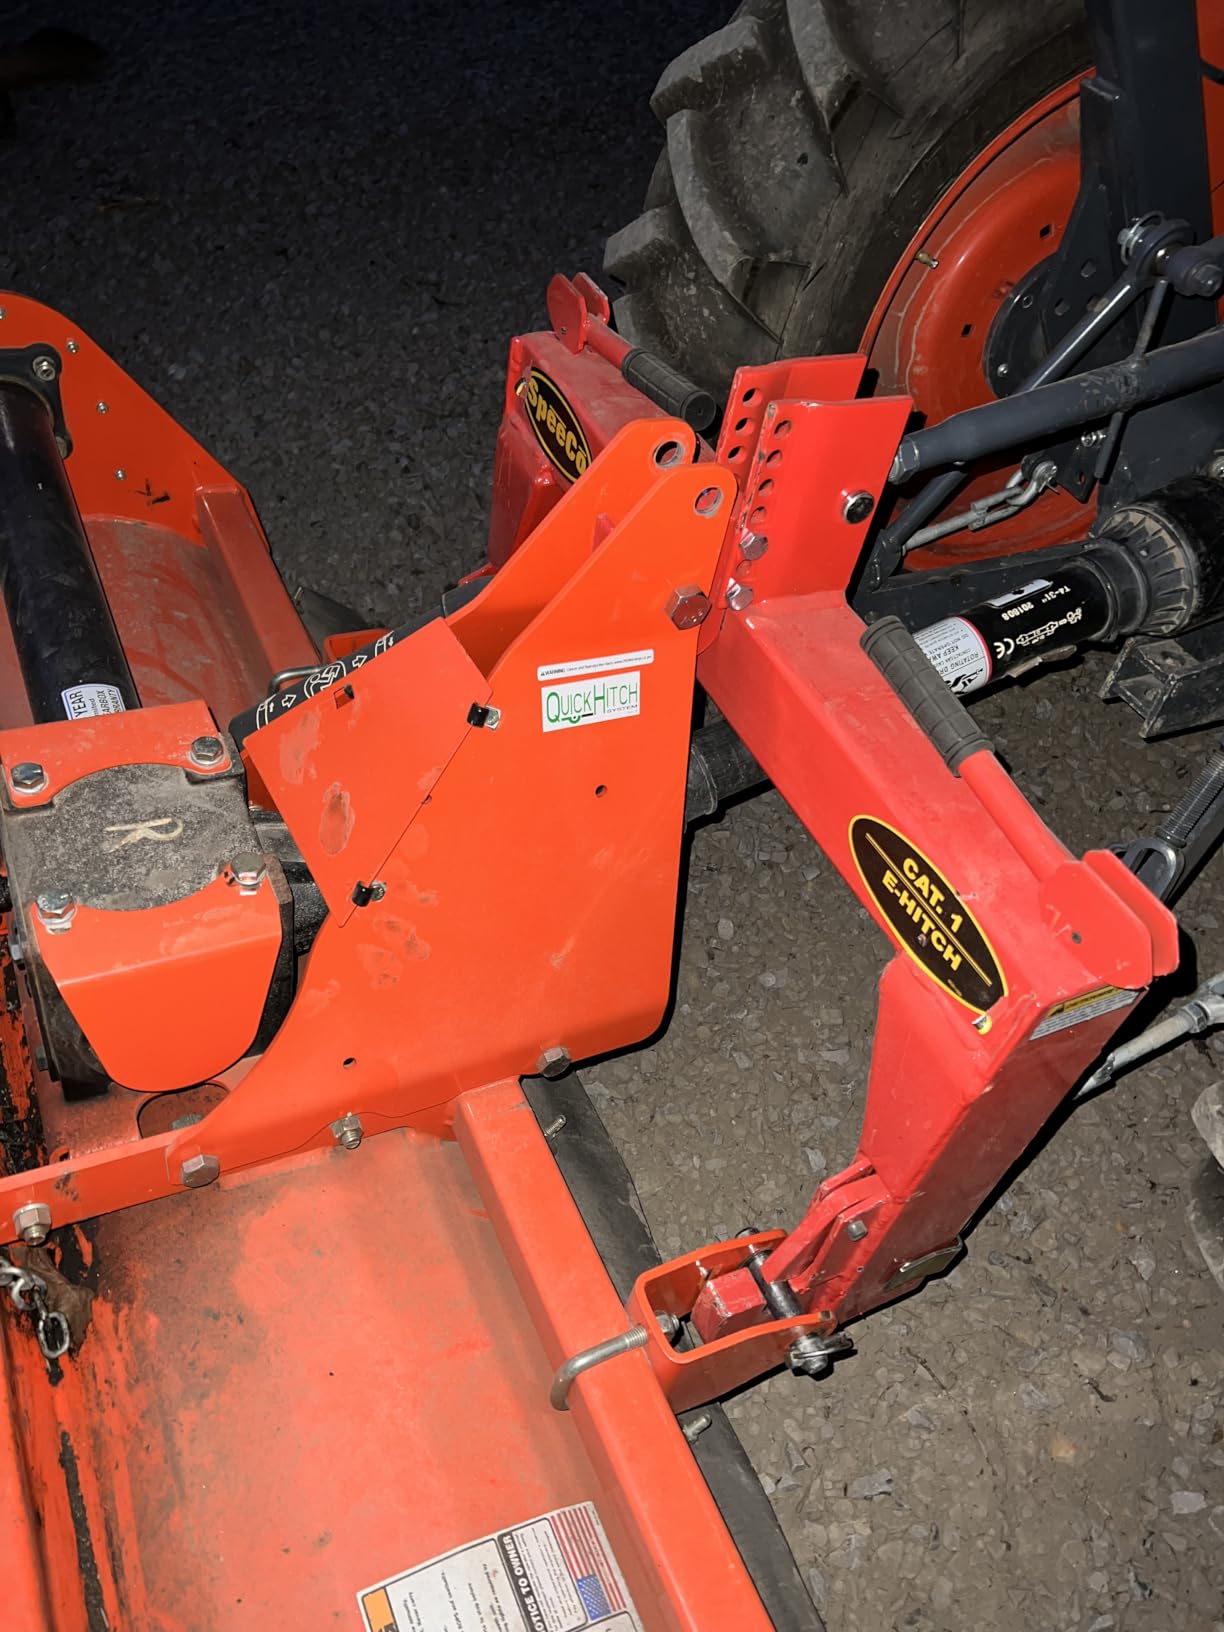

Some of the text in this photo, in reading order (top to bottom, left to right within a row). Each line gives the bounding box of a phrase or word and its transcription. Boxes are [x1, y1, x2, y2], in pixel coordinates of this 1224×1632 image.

[527, 378, 587, 475] SpeeCo
[942, 644, 960, 657] KEEP
[949, 651, 980, 670] ROTATING
[69, 690, 88, 718] YEAR
[902, 857, 964, 934] CAT. 1
[881, 869, 963, 972] E-HITCH
[502, 1534, 525, 1577] OWNER
[517, 1576, 532, 1596] TO
